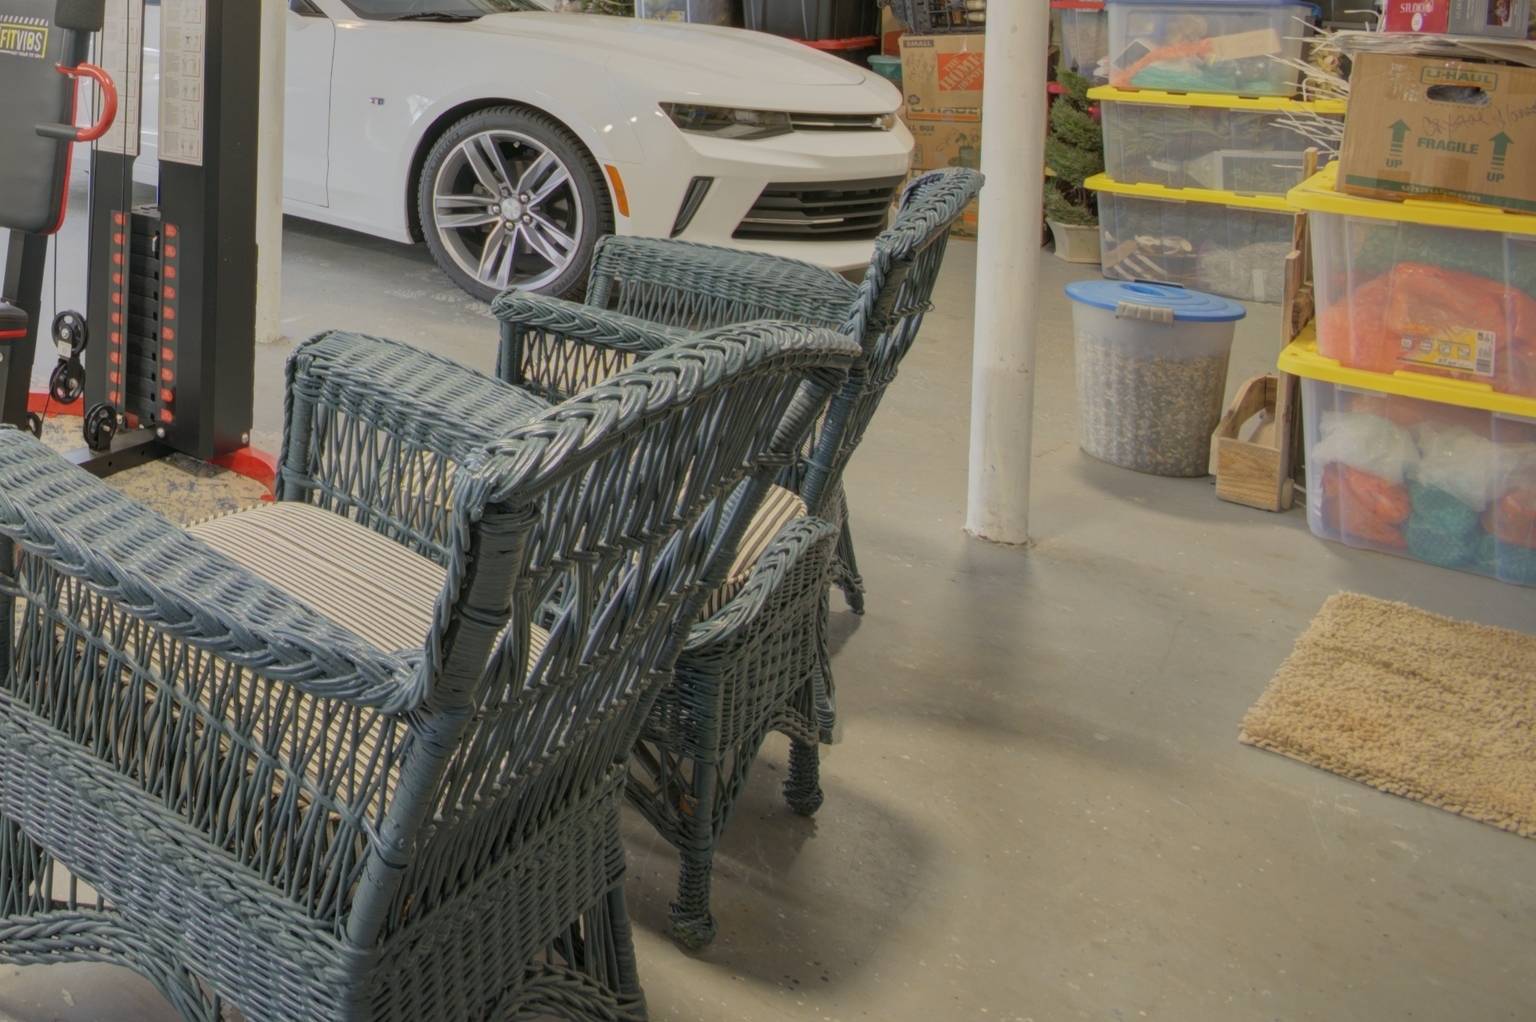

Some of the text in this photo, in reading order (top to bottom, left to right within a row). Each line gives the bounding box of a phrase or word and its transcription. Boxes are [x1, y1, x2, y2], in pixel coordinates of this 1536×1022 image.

[0, 29, 43, 52] FITVIBS
[1426, 70, 1493, 84] U-HAUL
[1417, 137, 1479, 155] FRAGILE
[1385, 158, 1403, 169] UP
[1486, 172, 1505, 182] UP
